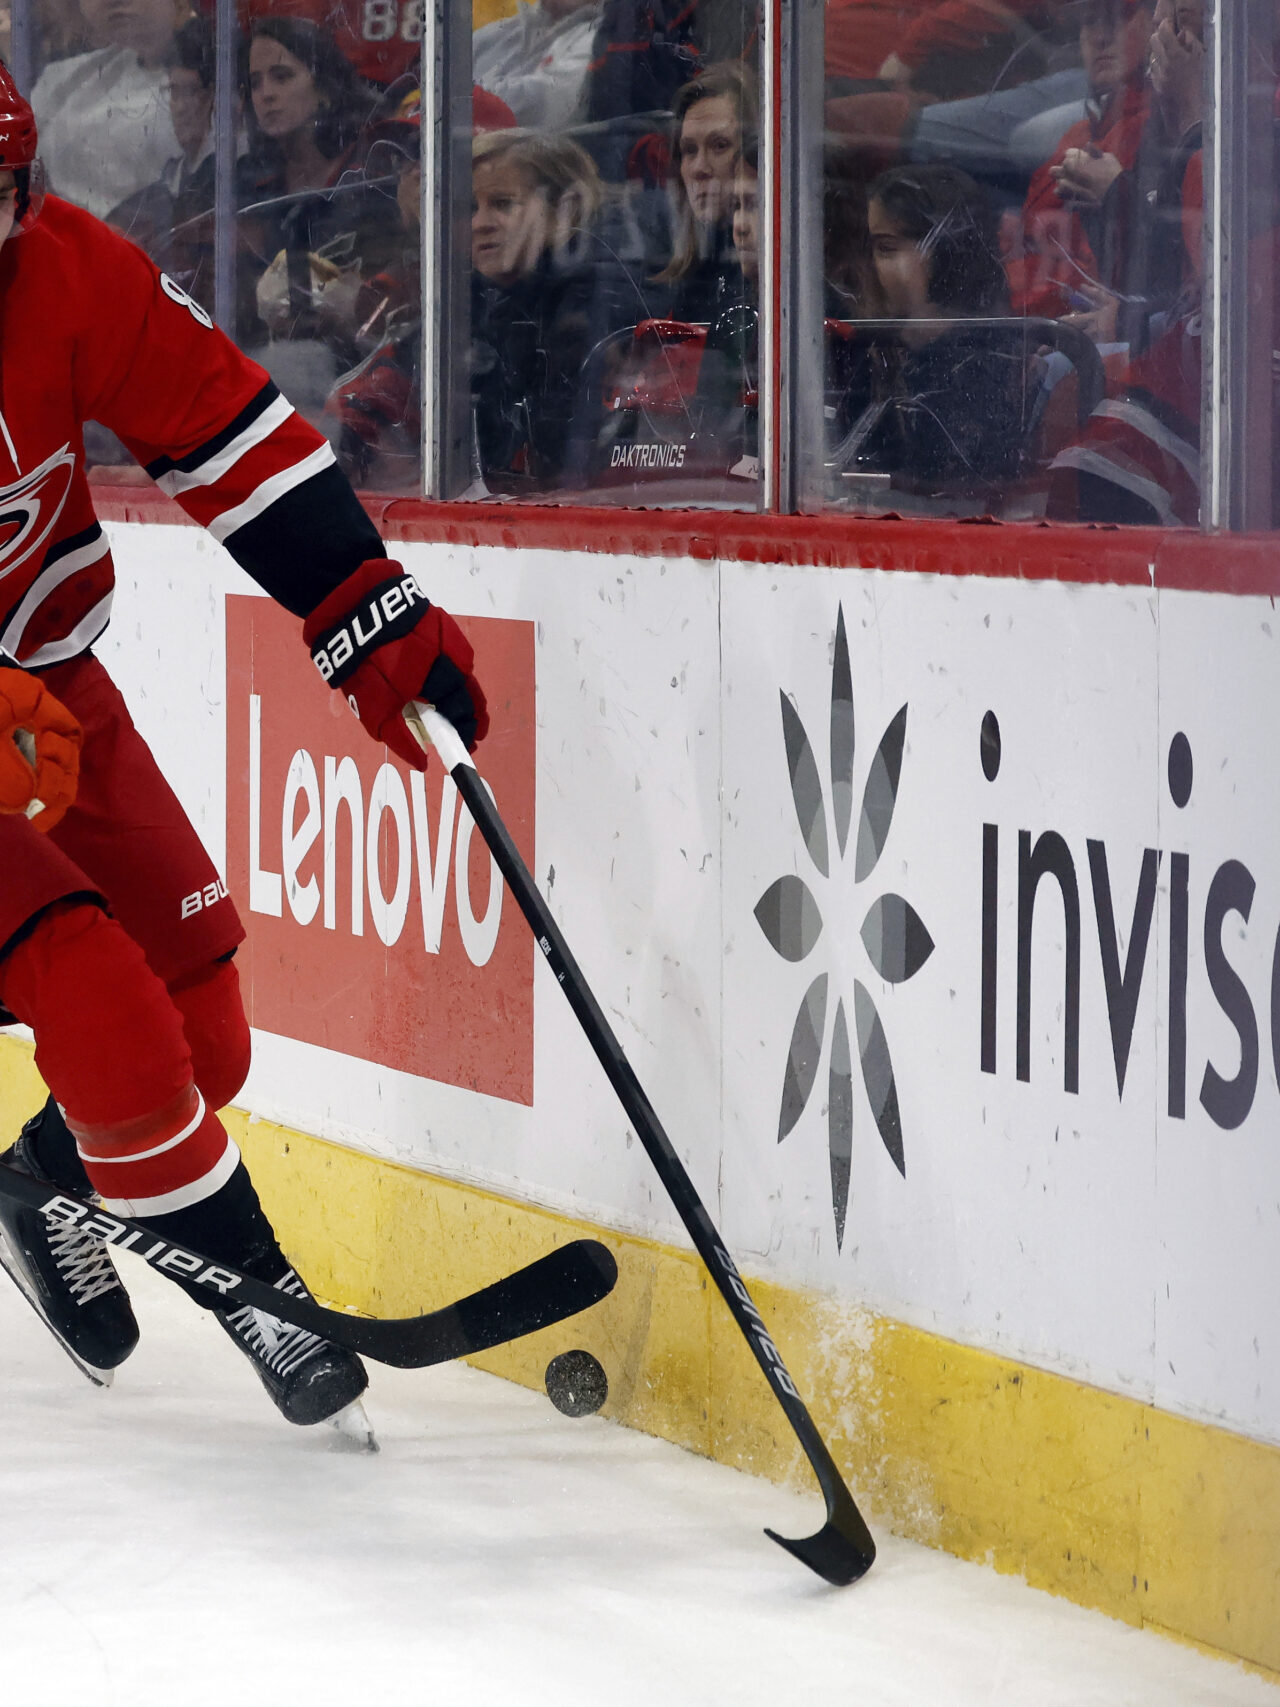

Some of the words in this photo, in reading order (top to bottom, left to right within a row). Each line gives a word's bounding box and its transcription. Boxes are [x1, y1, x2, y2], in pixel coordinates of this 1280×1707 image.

[610, 445, 686, 467] DAKTRONICS
[313, 576, 427, 681] BAUER
[249, 694, 504, 967] Lenovo
[980, 710, 1280, 1130] invis
[38, 1195, 243, 1295] BAUER
